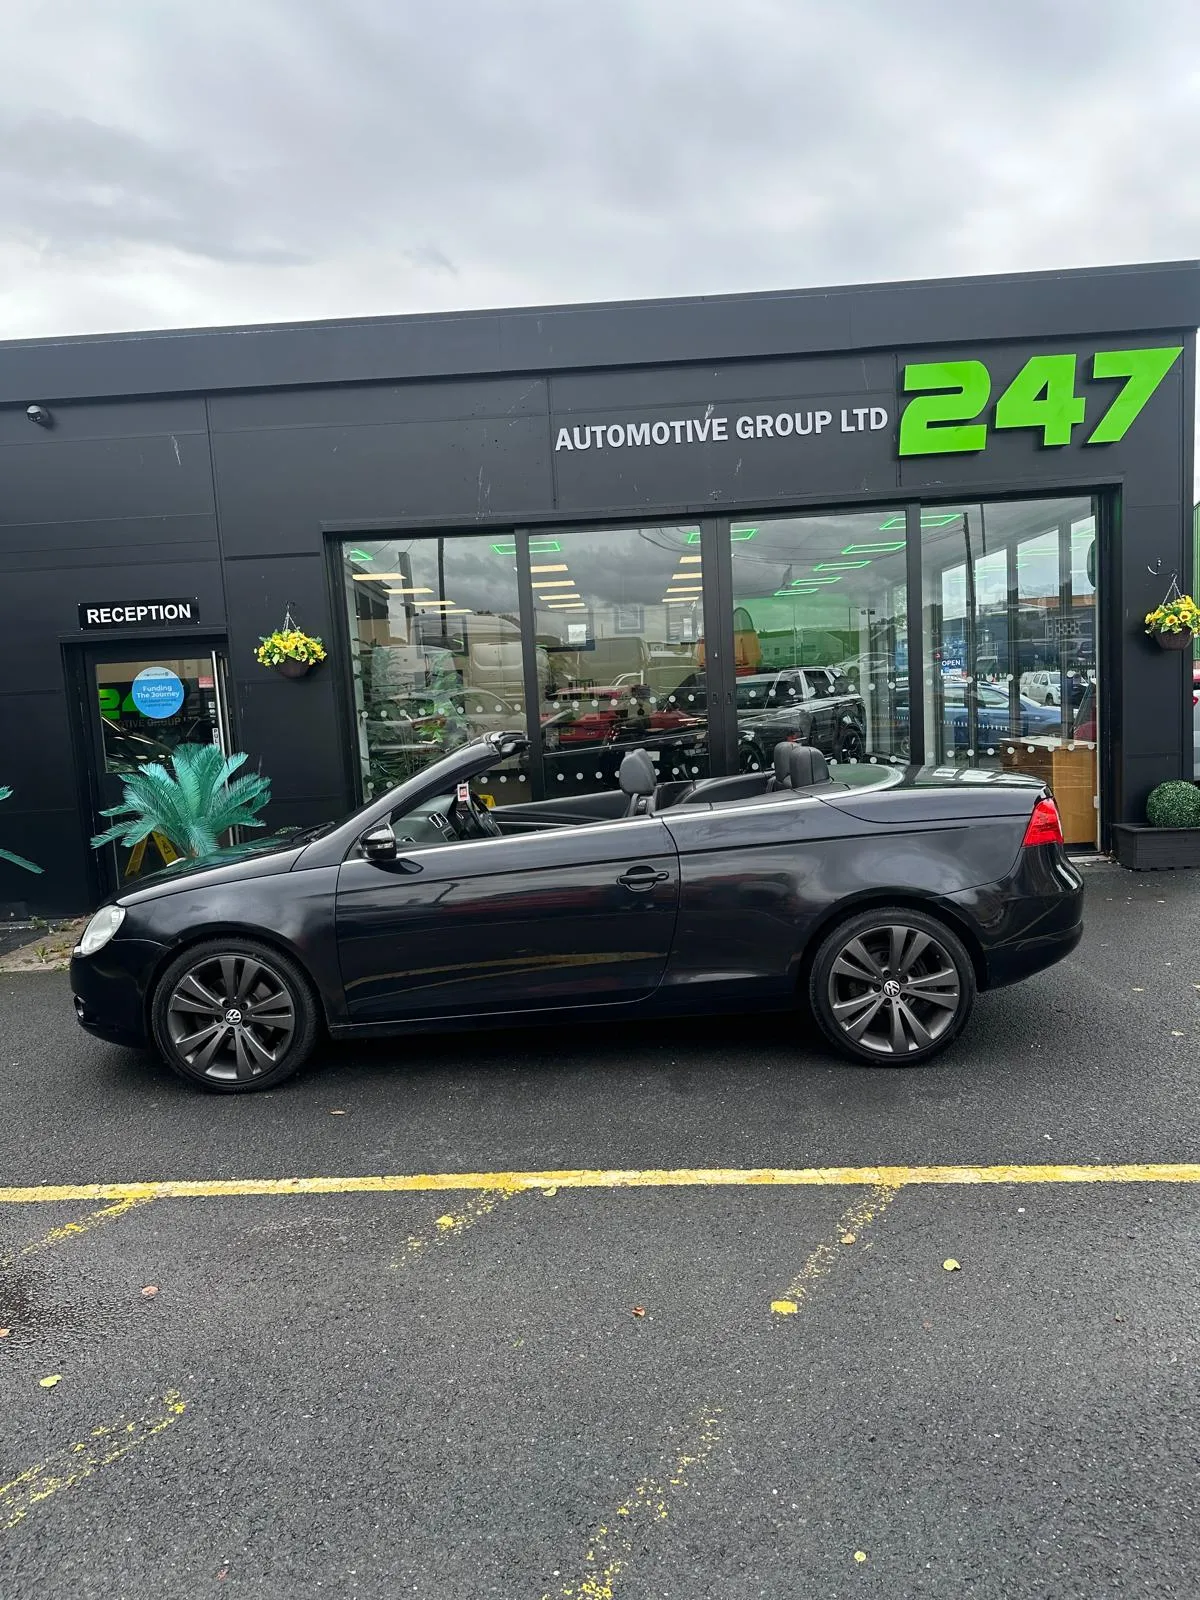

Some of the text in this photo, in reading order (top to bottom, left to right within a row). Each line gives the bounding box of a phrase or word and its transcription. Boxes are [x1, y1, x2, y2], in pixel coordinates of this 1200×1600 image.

[899, 346, 1185, 456] 247
[555, 406, 889, 451] AUTOMOTIVE GROUP LTD
[86, 604, 191, 623] RECEPTION
[142, 683, 173, 692] Funding
[151, 691, 180, 699] Journey
